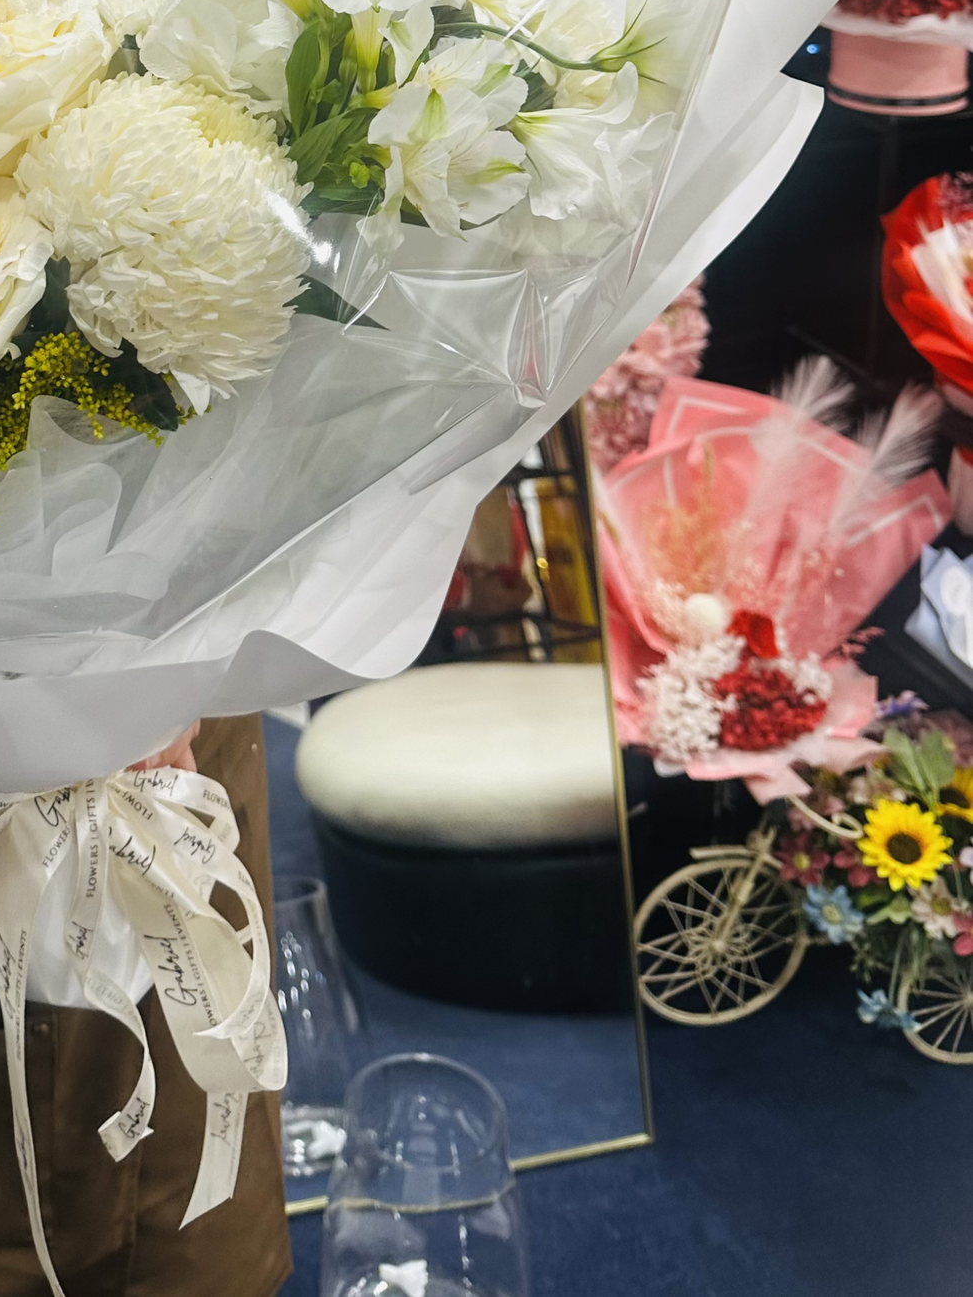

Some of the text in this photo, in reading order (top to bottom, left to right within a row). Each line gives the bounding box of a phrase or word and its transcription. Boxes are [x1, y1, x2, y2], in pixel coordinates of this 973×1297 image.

[133, 769, 179, 797] Gabriel
[86, 797, 98, 833] GIFTS
[86, 843, 99, 899] FLOWERS
[108, 825, 157, 876] abriel
[143, 933, 198, 1007] Gabriel
